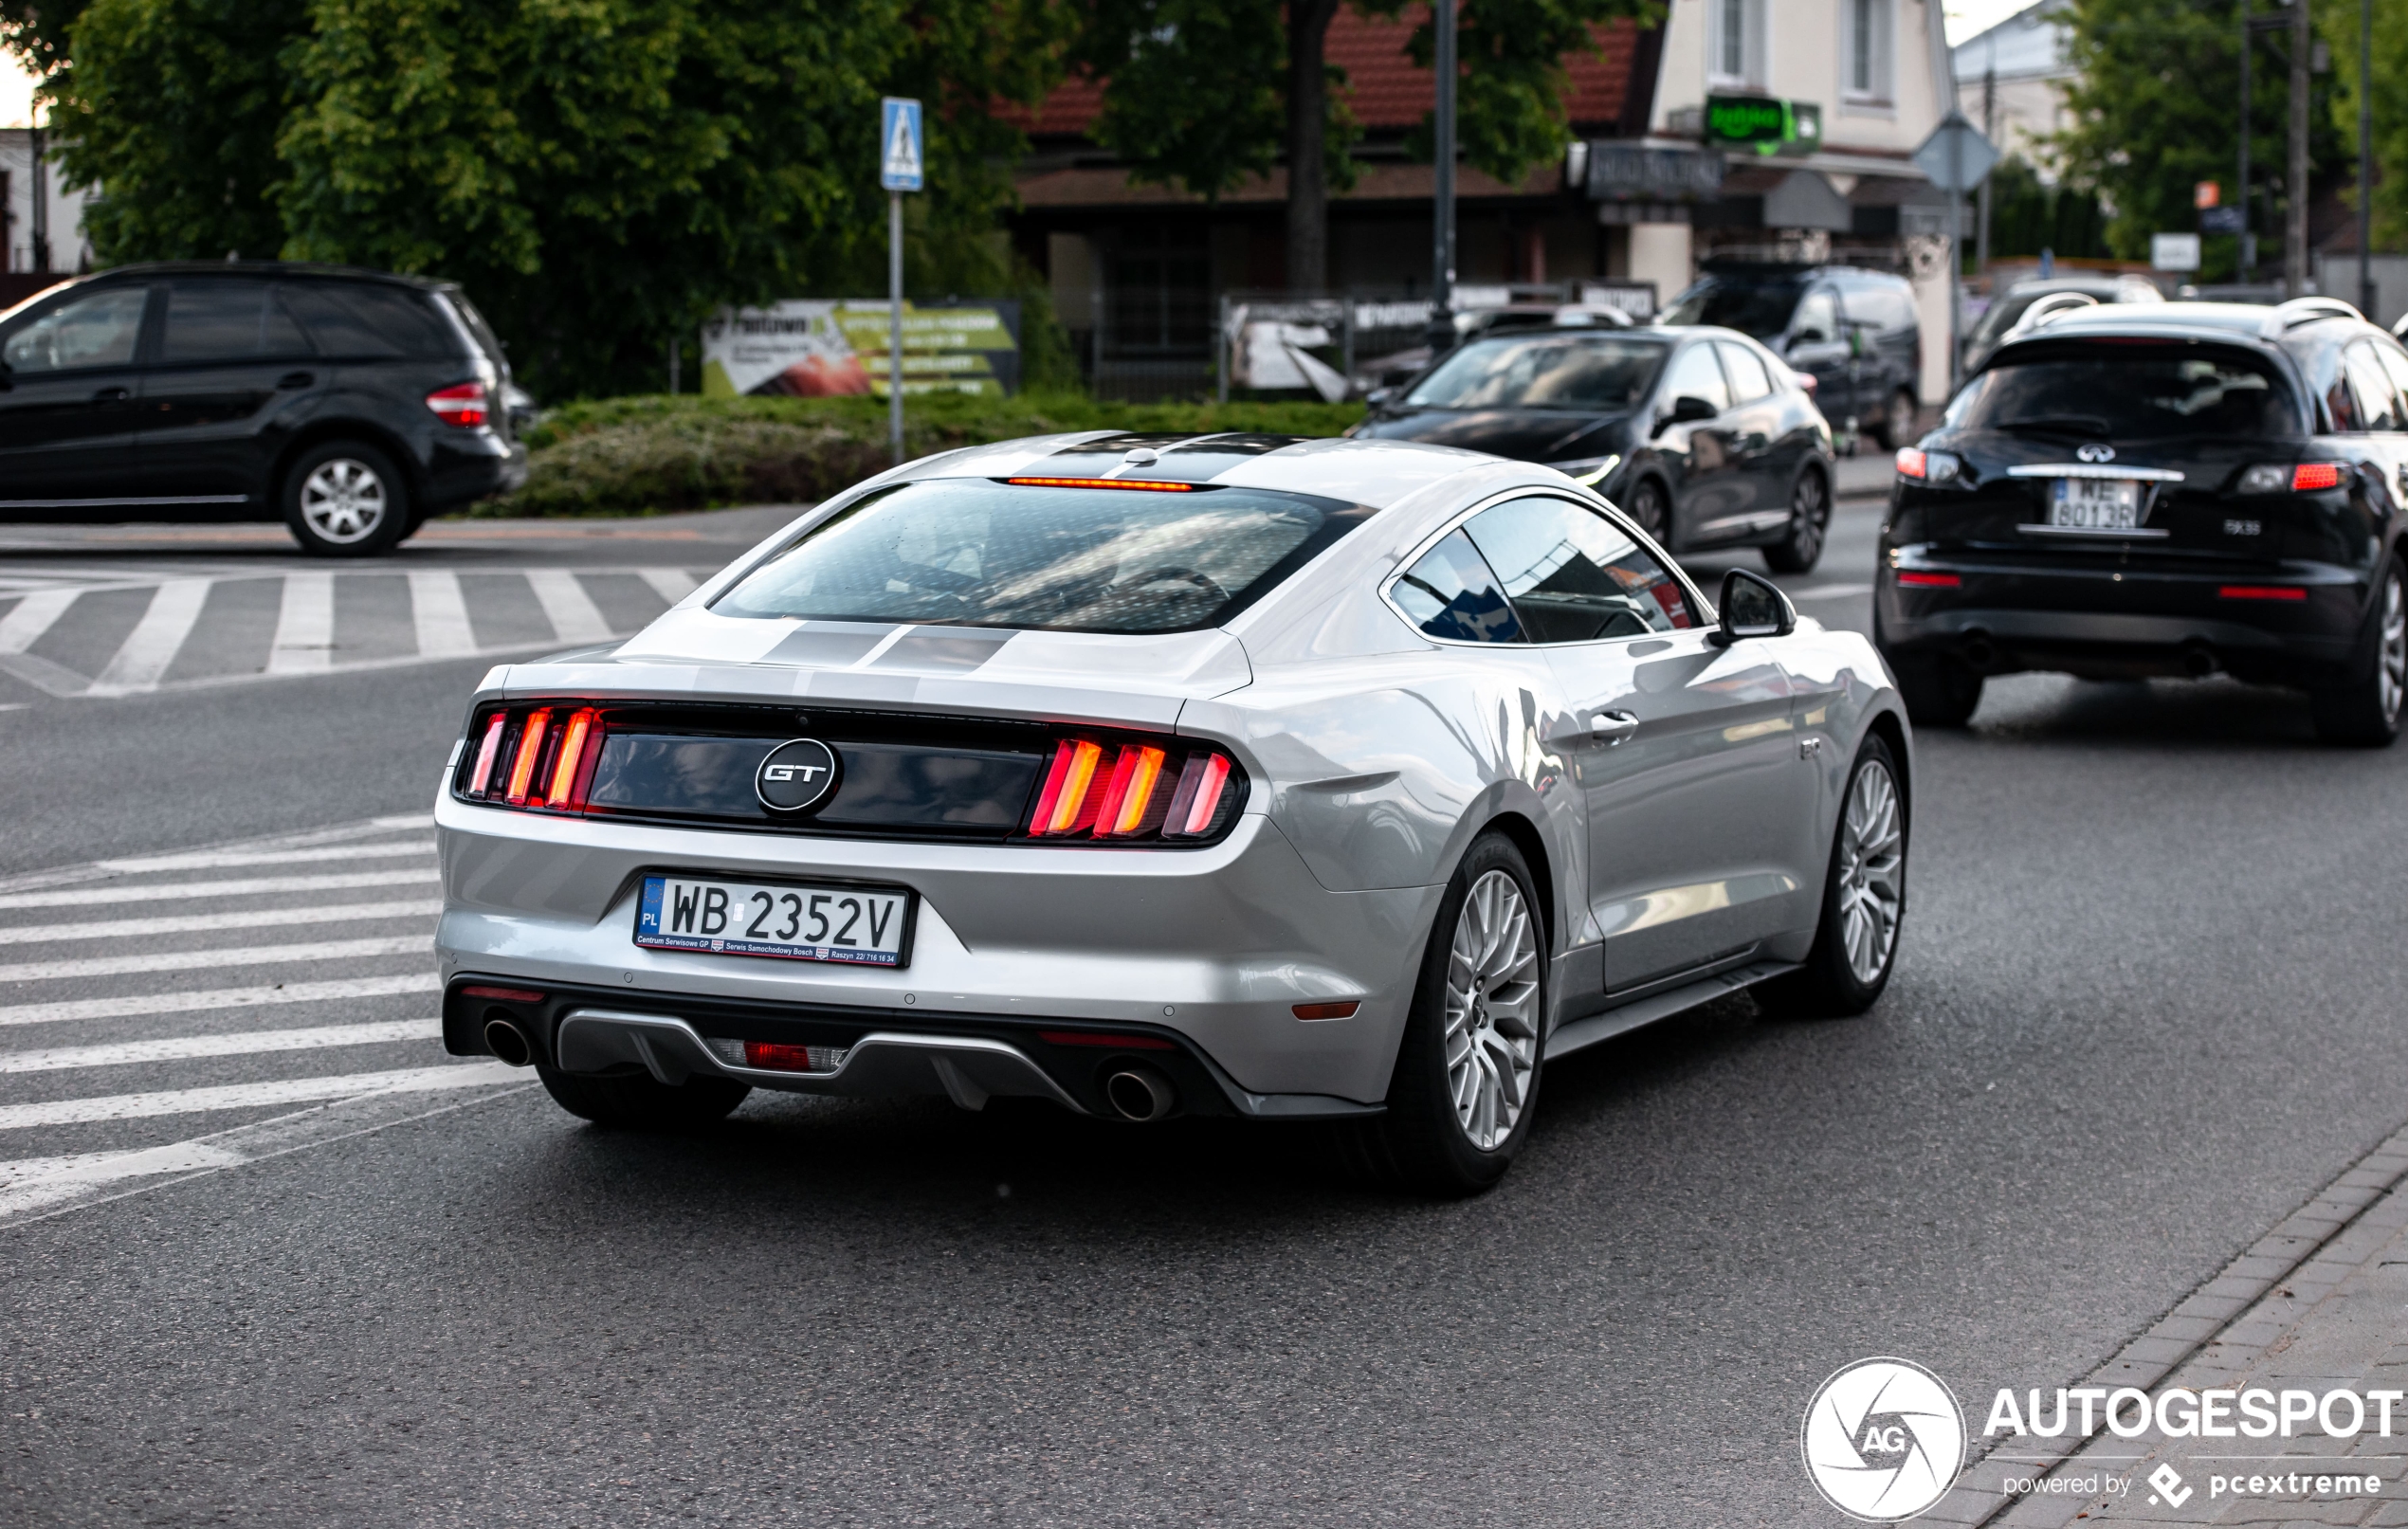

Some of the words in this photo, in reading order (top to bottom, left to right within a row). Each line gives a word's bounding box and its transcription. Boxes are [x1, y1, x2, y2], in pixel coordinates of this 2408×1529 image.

[764, 764, 827, 782] GT
[642, 913, 657, 926] PL
[671, 884, 729, 935] WB
[745, 890, 894, 948] 2352V
[637, 936, 665, 945] Centrum
[665, 937, 699, 948] Serwisowe
[726, 942, 747, 952] Serwis
[748, 944, 793, 956] Samochodowy
[831, 951, 854, 959] Raszyn
